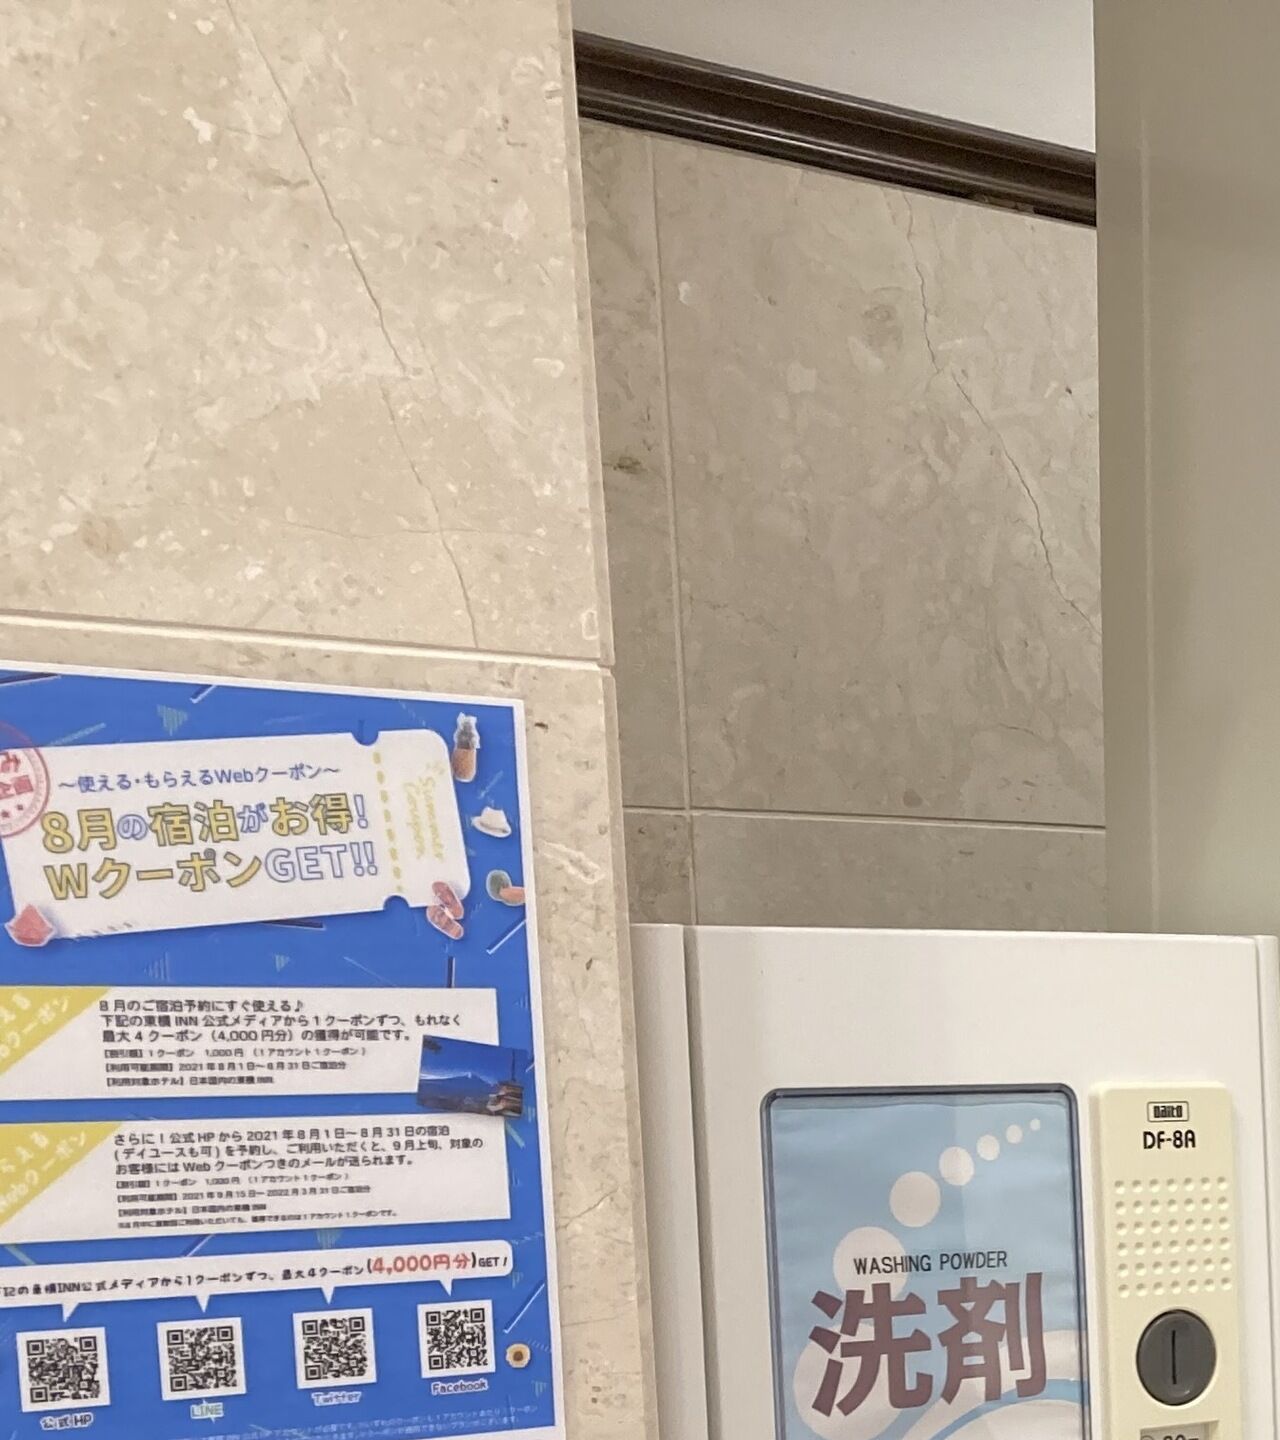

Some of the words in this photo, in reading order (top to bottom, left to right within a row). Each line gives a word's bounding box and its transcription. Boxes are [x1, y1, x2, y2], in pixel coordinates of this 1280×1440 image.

[1143, 1130, 1196, 1149] DF-8A
[854, 1255, 931, 1275] WASHING
[940, 1251, 1008, 1270] POWDER
[808, 1272, 1047, 1417] 洗剤
[431, 1381, 488, 1396] Facebook
[312, 1392, 361, 1406] Twitter
[191, 1403, 223, 1419] LINE
